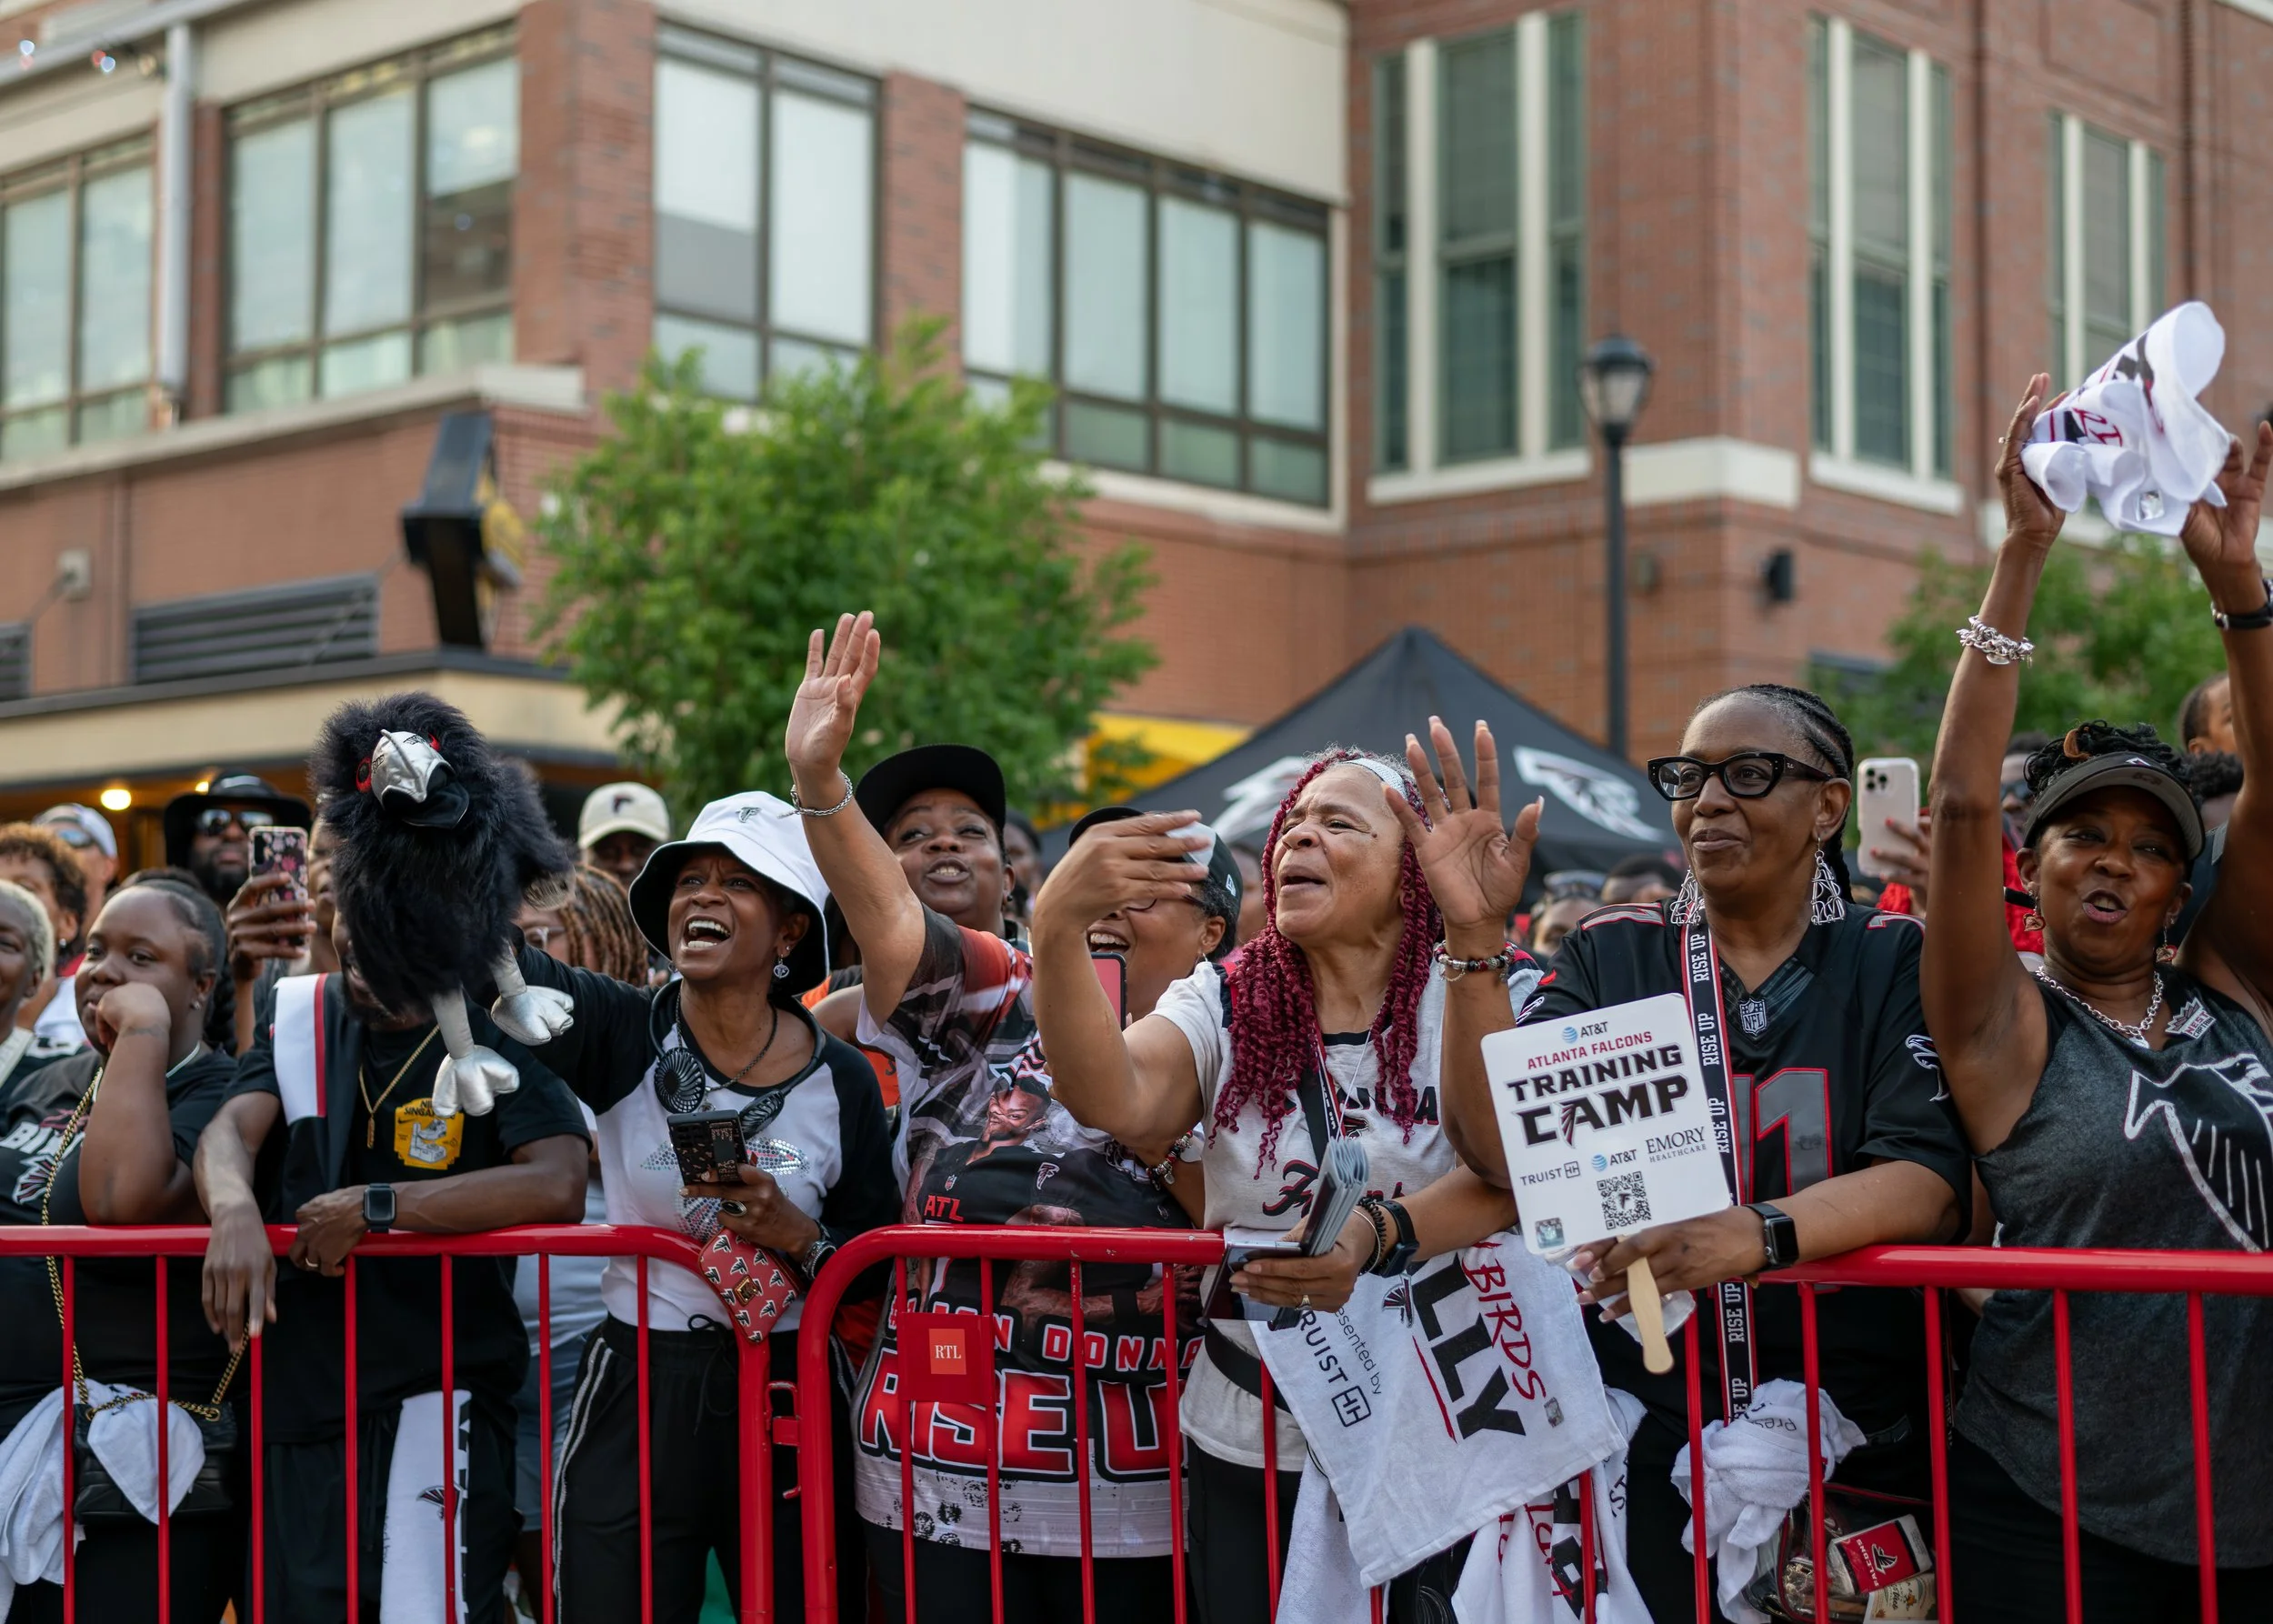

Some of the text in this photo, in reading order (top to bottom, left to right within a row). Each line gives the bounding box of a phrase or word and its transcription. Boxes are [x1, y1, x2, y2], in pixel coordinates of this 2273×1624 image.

[1690, 933, 1710, 984] RISE UP
[1580, 1021, 1608, 1038] AT&T
[1697, 1012, 1720, 1068] RISE UP
[1744, 1013, 1765, 1030] NFL
[2185, 1011, 2208, 1034] NEST
[1507, 1043, 1684, 1102] TRAINING
[1527, 1031, 1653, 1070] ATLANTA FALCONS
[1514, 1073, 1689, 1148] CAMP
[1707, 1098, 1730, 1154] RISE UP
[1646, 1127, 1706, 1155] EMORY
[1649, 1143, 1707, 1163] HEALTHCARE
[1520, 1149, 1637, 1187] TRUIST AT&T
[924, 1194, 965, 1222] ATL
[1462, 1258, 1547, 1400] BIRDS
[1725, 1283, 1746, 1343] RISE UP
[935, 1344, 962, 1359] RTL
[1300, 1309, 1348, 1384] RUIST
[1335, 1306, 1382, 1396] esented by
[1411, 1251, 1527, 1440] LLY
[1731, 1377, 1748, 1399] UP
[1096, 1378, 1185, 1475] U
[1856, 1538, 1880, 1588] FALCONS
